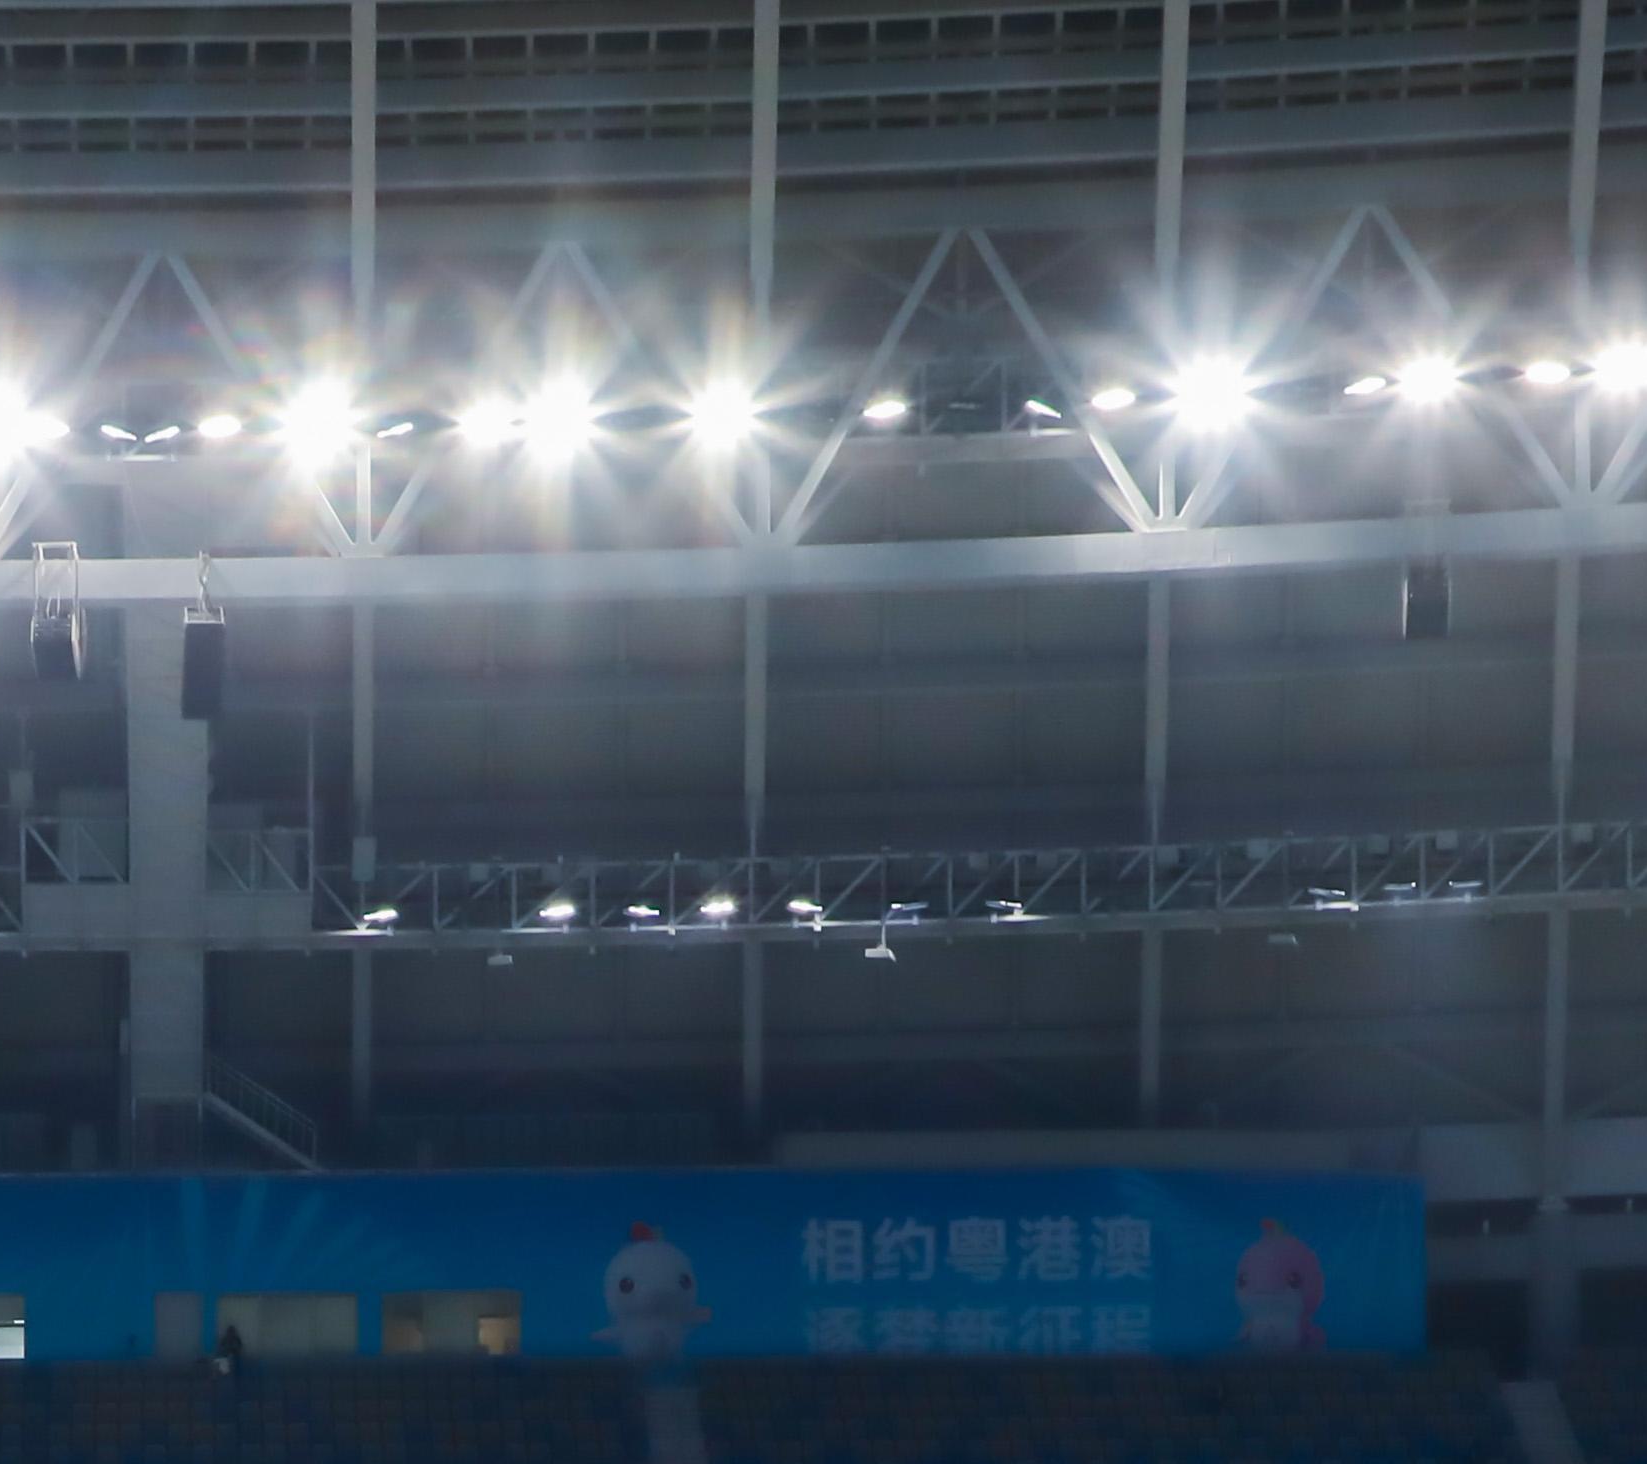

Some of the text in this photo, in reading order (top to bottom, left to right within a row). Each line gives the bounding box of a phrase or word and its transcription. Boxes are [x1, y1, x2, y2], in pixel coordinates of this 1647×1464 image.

[803, 1217, 1154, 1284] 相约粤港澳
